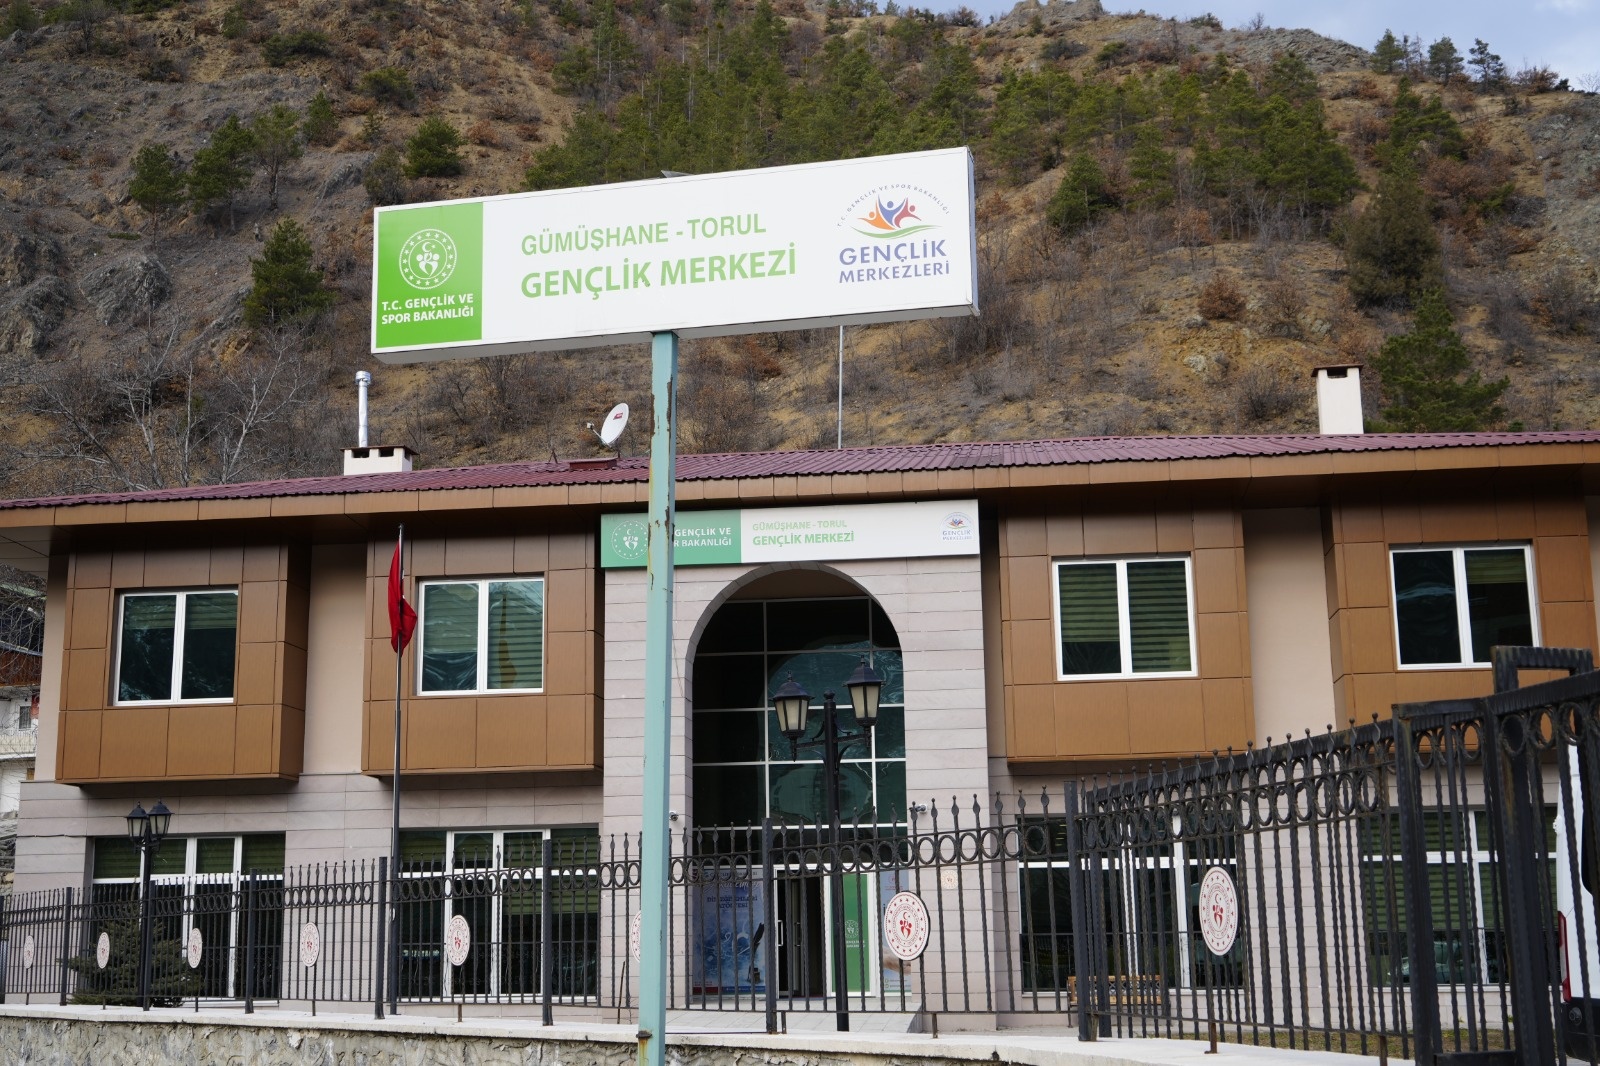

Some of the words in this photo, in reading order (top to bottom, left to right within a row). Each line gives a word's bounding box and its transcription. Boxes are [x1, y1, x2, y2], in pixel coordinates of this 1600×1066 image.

[521, 222, 669, 256] GÜMÜŞHANE
[687, 213, 768, 240] TORUL
[839, 239, 947, 266] GENÇLİK
[521, 257, 652, 300] GENÇLİK
[660, 241, 797, 287] MERKEZİ
[839, 260, 950, 283] MERKEZLERİ
[381, 301, 402, 312] T.C.
[405, 294, 455, 310] GENÇLİK
[459, 293, 474, 304] VE
[381, 313, 411, 325] SPOR
[413, 305, 474, 321] BAKANLIĞI
[674, 527, 716, 538] GENÇLİK
[719, 527, 732, 535] VE
[752, 521, 811, 532] GÜMÜŞHANE
[817, 519, 848, 529] TORUL
[681, 536, 732, 547] BAKANLIĞI
[752, 533, 802, 547] GENÇLİK
[804, 530, 855, 544] MERKEZİ
